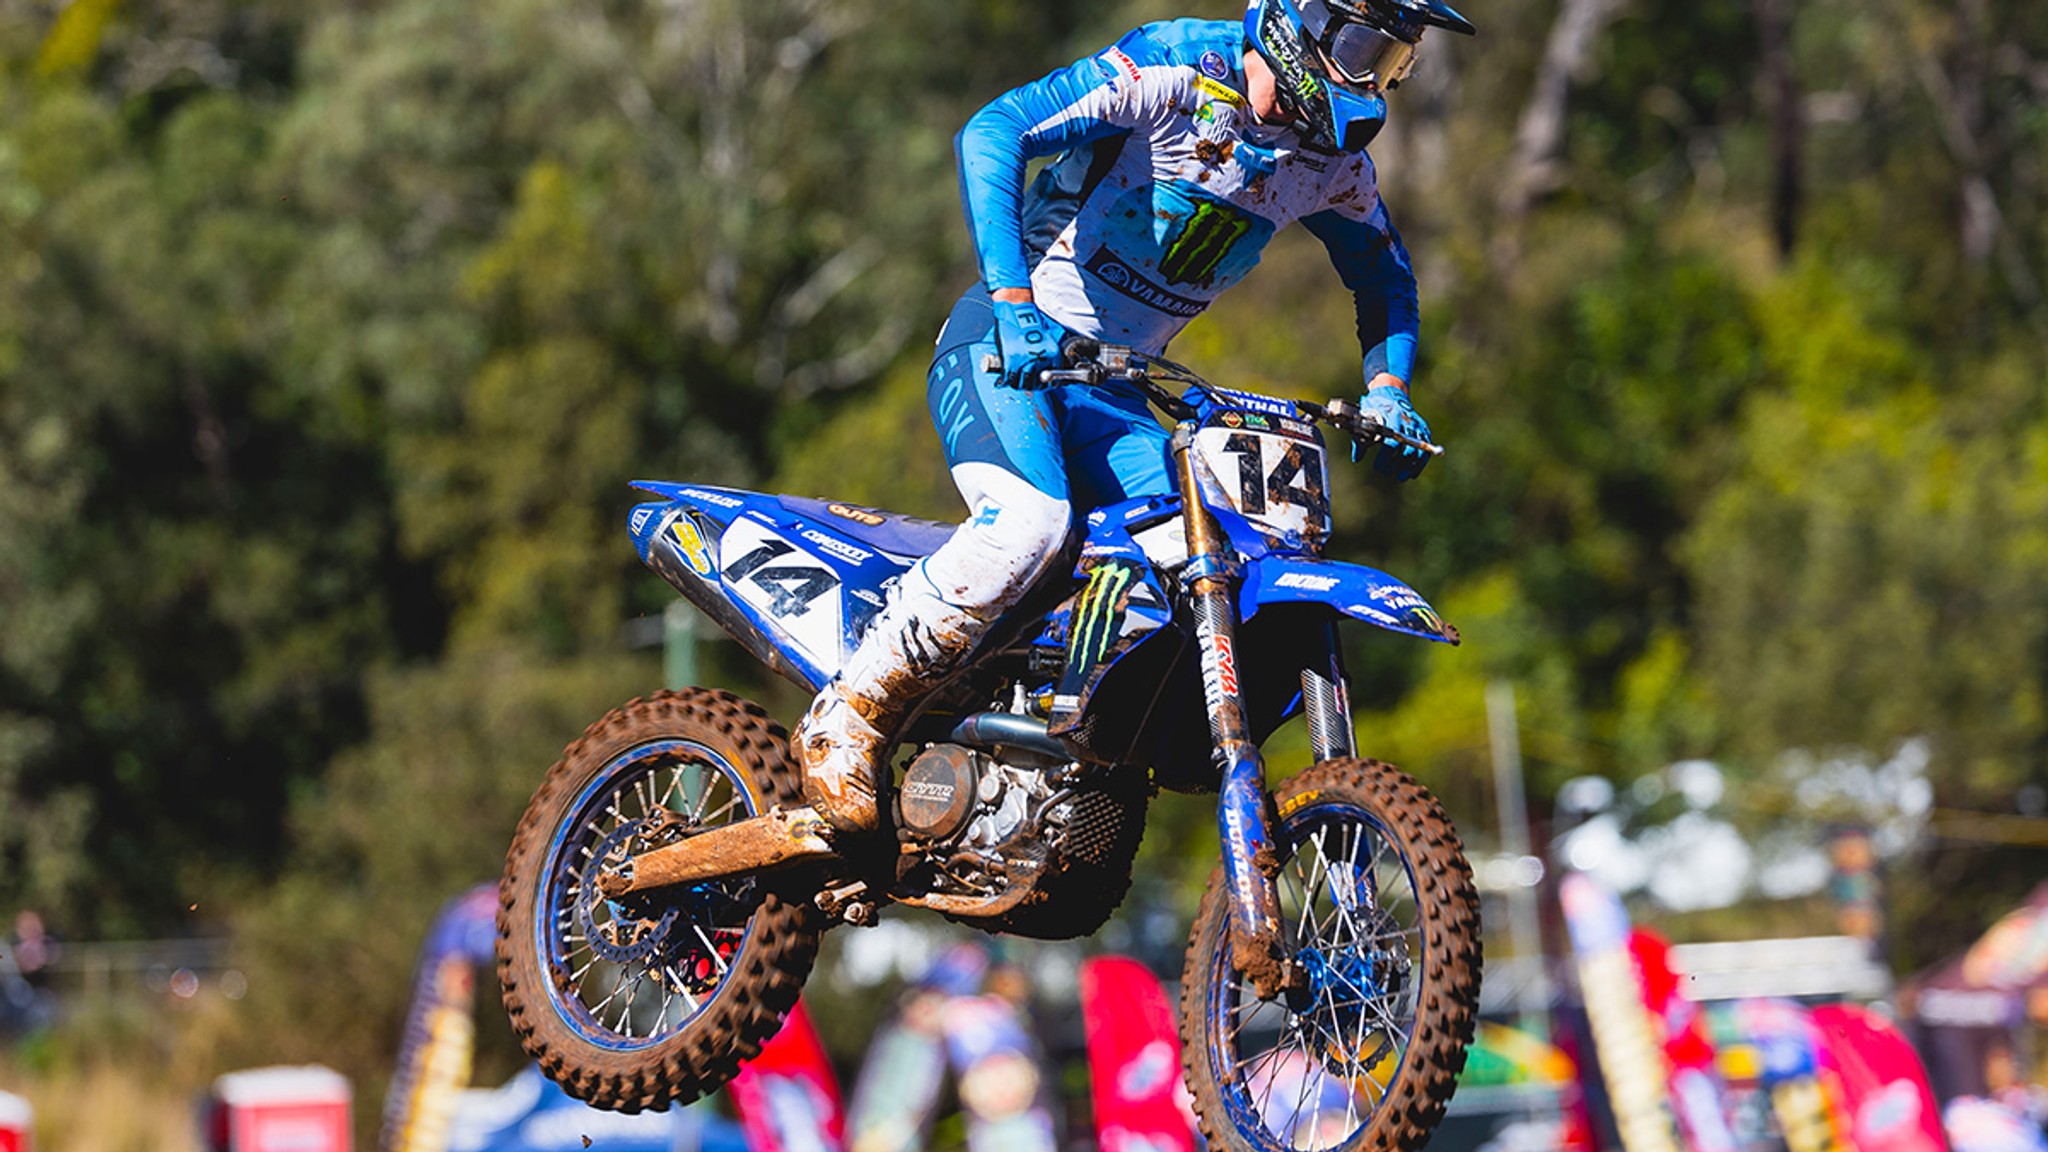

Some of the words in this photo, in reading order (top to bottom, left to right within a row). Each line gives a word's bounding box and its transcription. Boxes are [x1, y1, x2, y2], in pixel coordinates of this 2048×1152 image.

[1017, 311, 1047, 362] FOX
[1210, 391, 1293, 417] NTHAL
[1222, 433, 1327, 532] 14
[721, 538, 842, 620] 14
[1213, 633, 1239, 697] KYB
